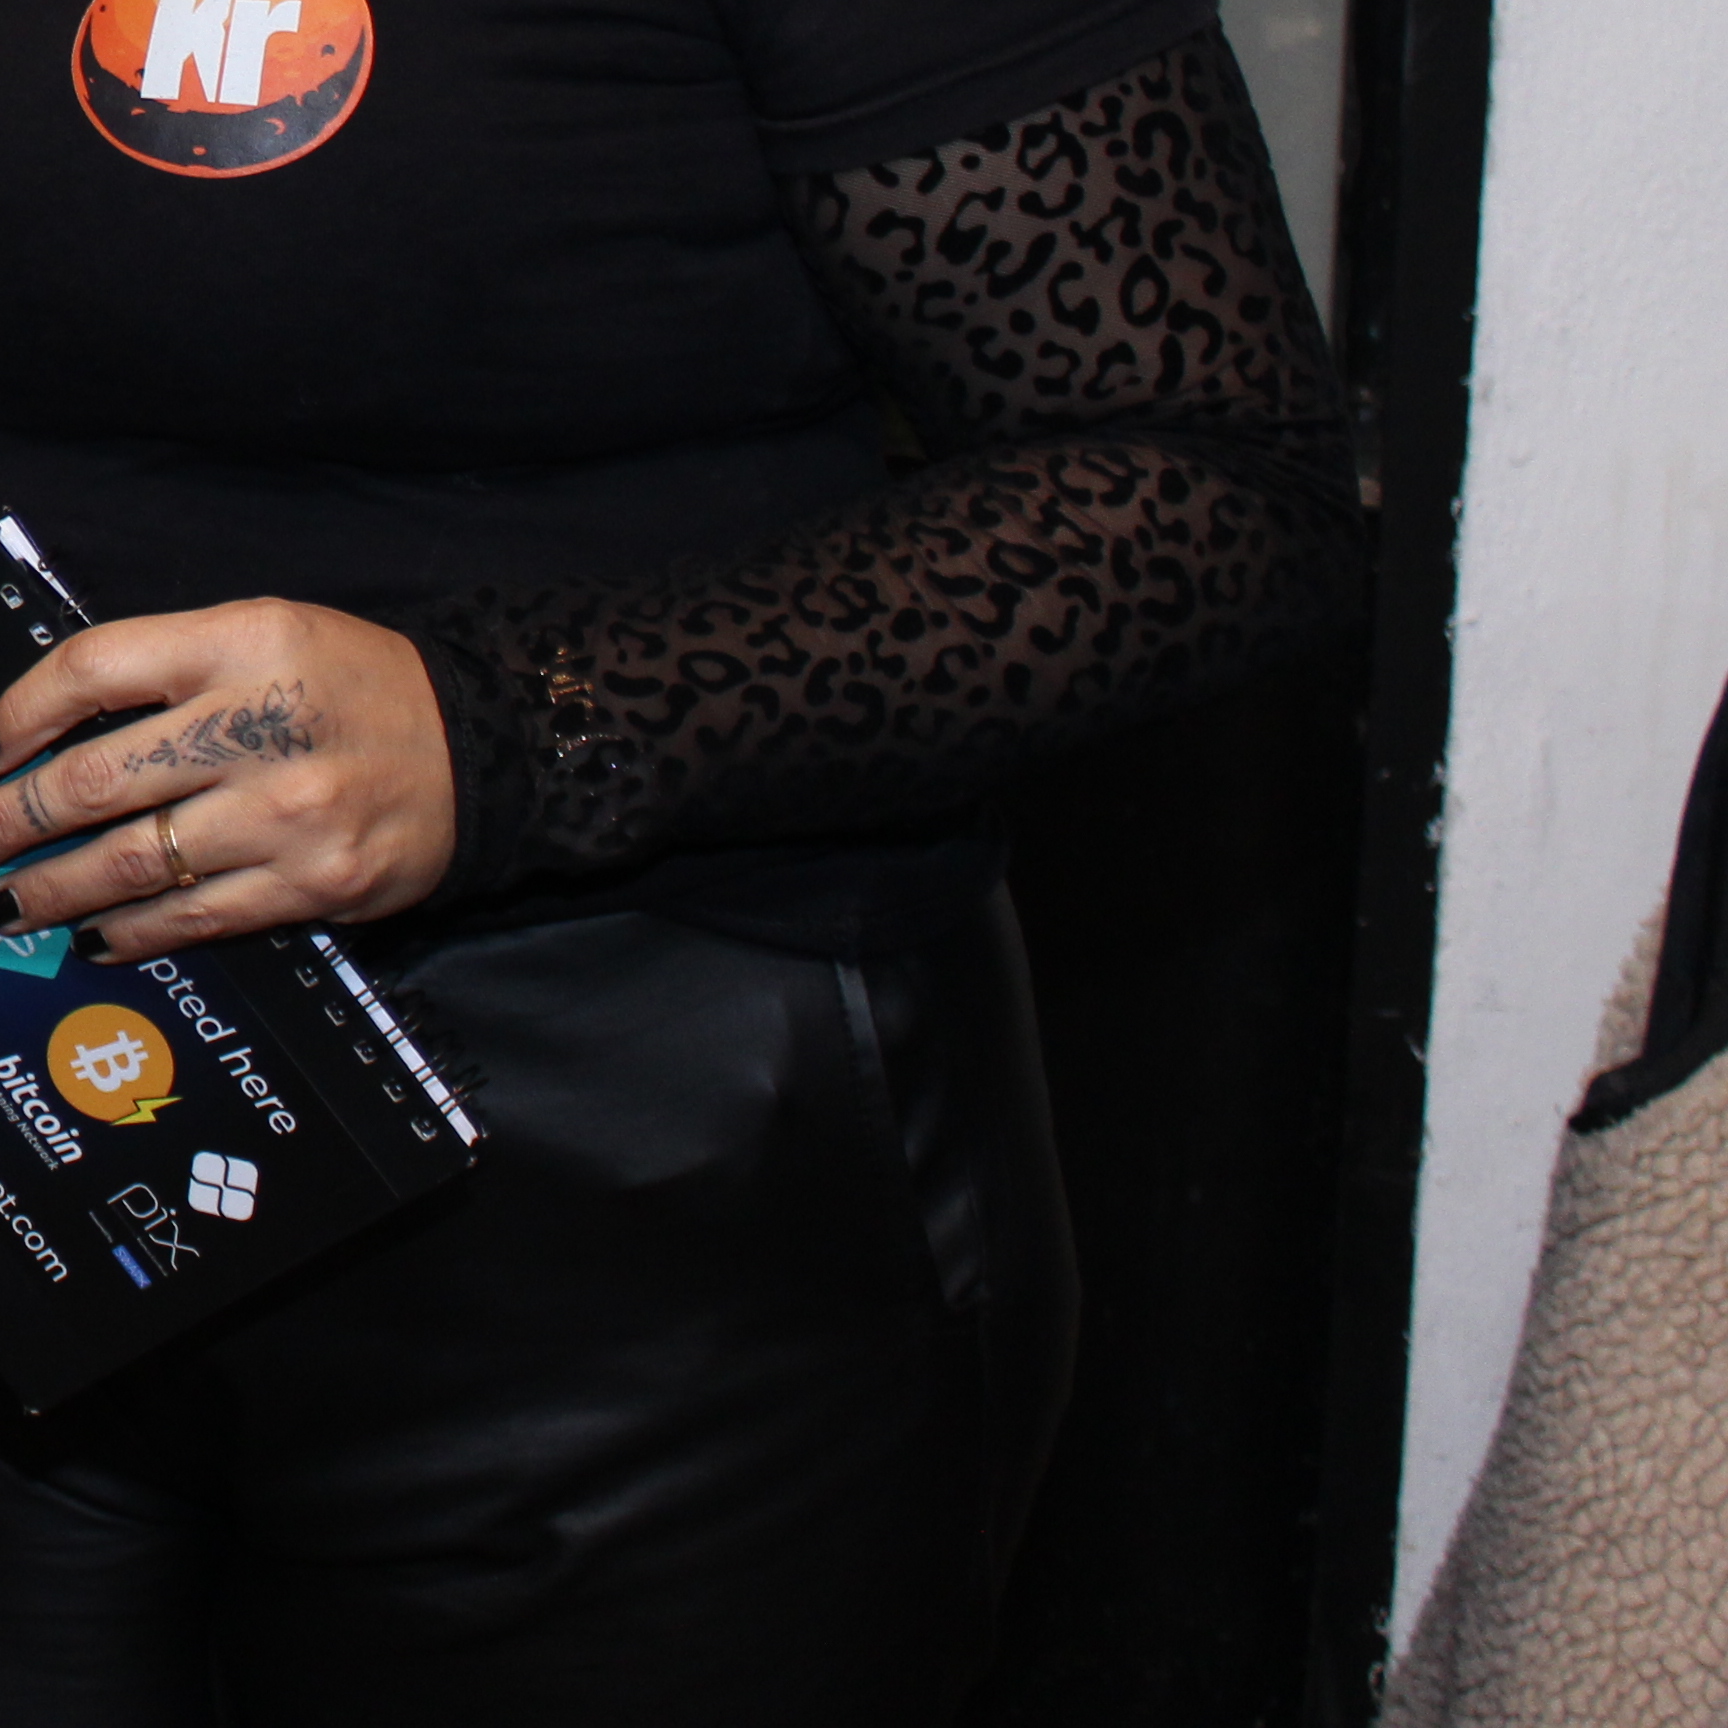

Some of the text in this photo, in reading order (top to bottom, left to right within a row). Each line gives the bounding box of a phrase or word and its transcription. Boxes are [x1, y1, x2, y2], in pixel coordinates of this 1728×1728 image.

[137, 957, 296, 1135] pted here
[17, 1121, 59, 1171] Network
[107, 1182, 200, 1271] pix
